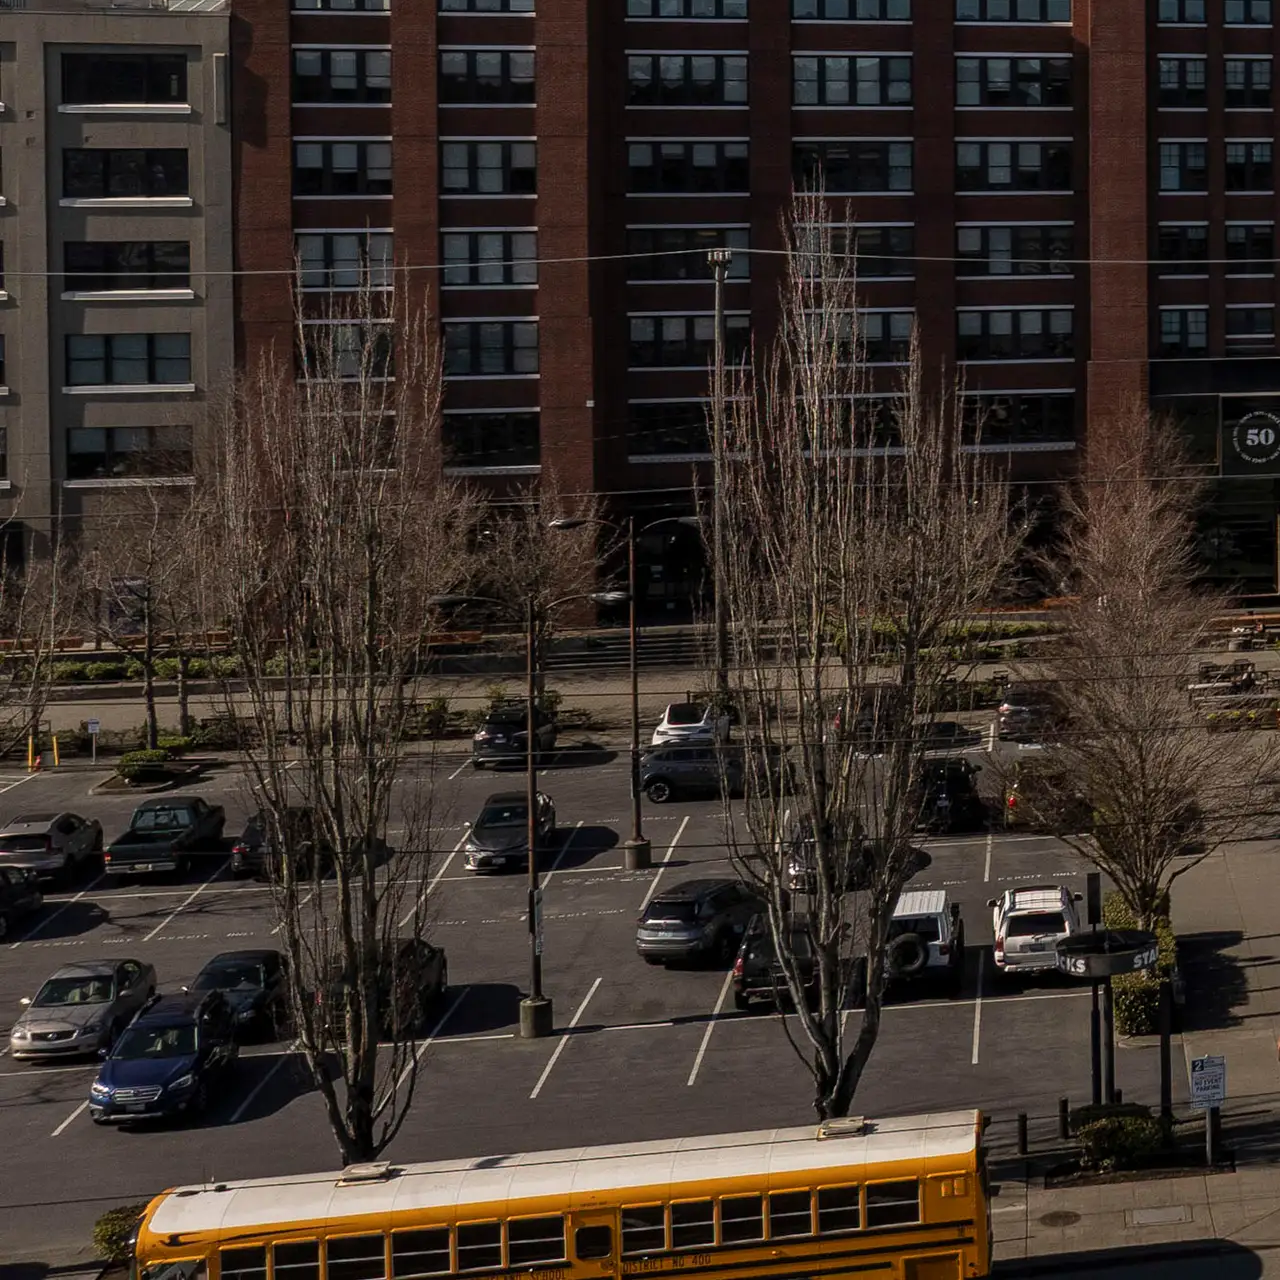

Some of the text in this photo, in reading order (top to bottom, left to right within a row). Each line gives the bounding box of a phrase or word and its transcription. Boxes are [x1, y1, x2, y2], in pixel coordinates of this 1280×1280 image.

[1246, 428, 1275, 445] 50
[622, 1259, 663, 1273] DISTRICT
[691, 1254, 712, 1266] 400
